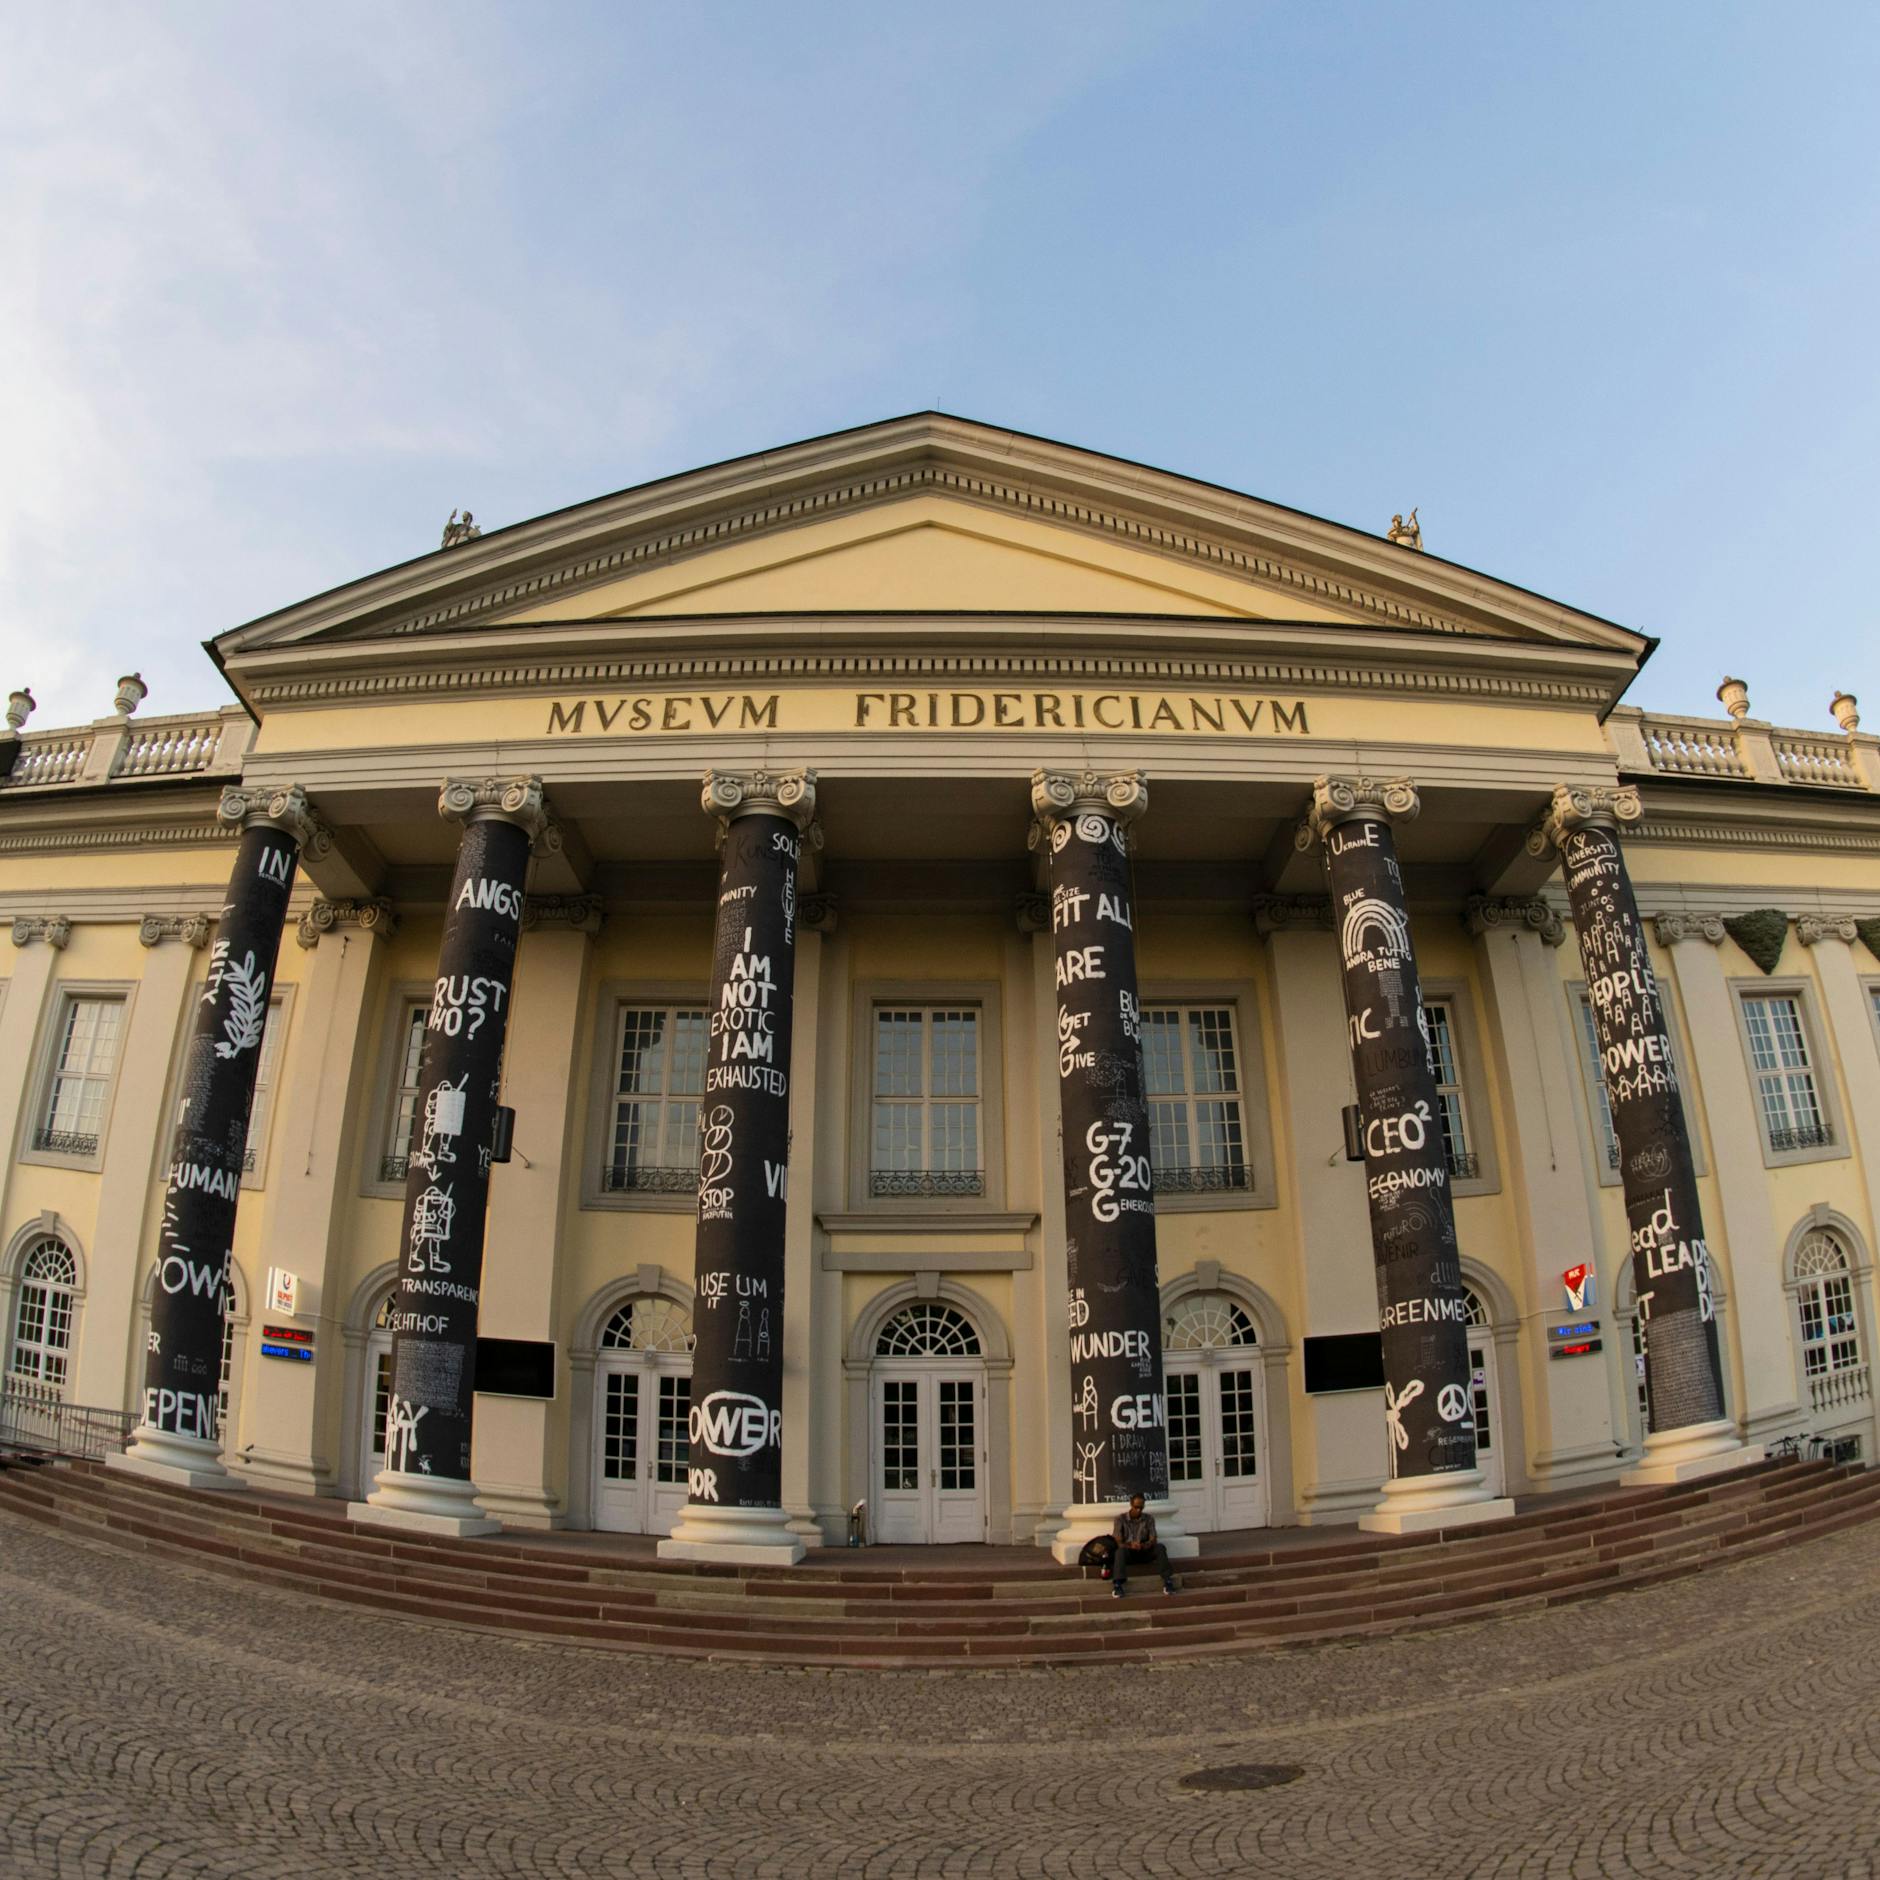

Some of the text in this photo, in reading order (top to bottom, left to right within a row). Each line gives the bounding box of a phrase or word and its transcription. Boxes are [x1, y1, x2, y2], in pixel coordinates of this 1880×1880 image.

[546, 692, 1311, 737] MVSEVM FRIDERICIANVM
[258, 846, 292, 882] IN
[1568, 862, 1620, 893] COMMUNITY
[744, 926, 752, 953] I
[729, 953, 772, 982] AM
[1368, 958, 1401, 973] BENE
[721, 980, 778, 1010] NOT
[1589, 970, 1658, 1009] PEOPLE
[711, 1007, 777, 1037] EXOTIC
[721, 1031, 773, 1064] I AM
[706, 1064, 788, 1098] EXHAUSTED
[701, 1187, 735, 1210] STOP
[1368, 1167, 1445, 1200] ECONOMY
[707, 1296, 721, 1310] IT
